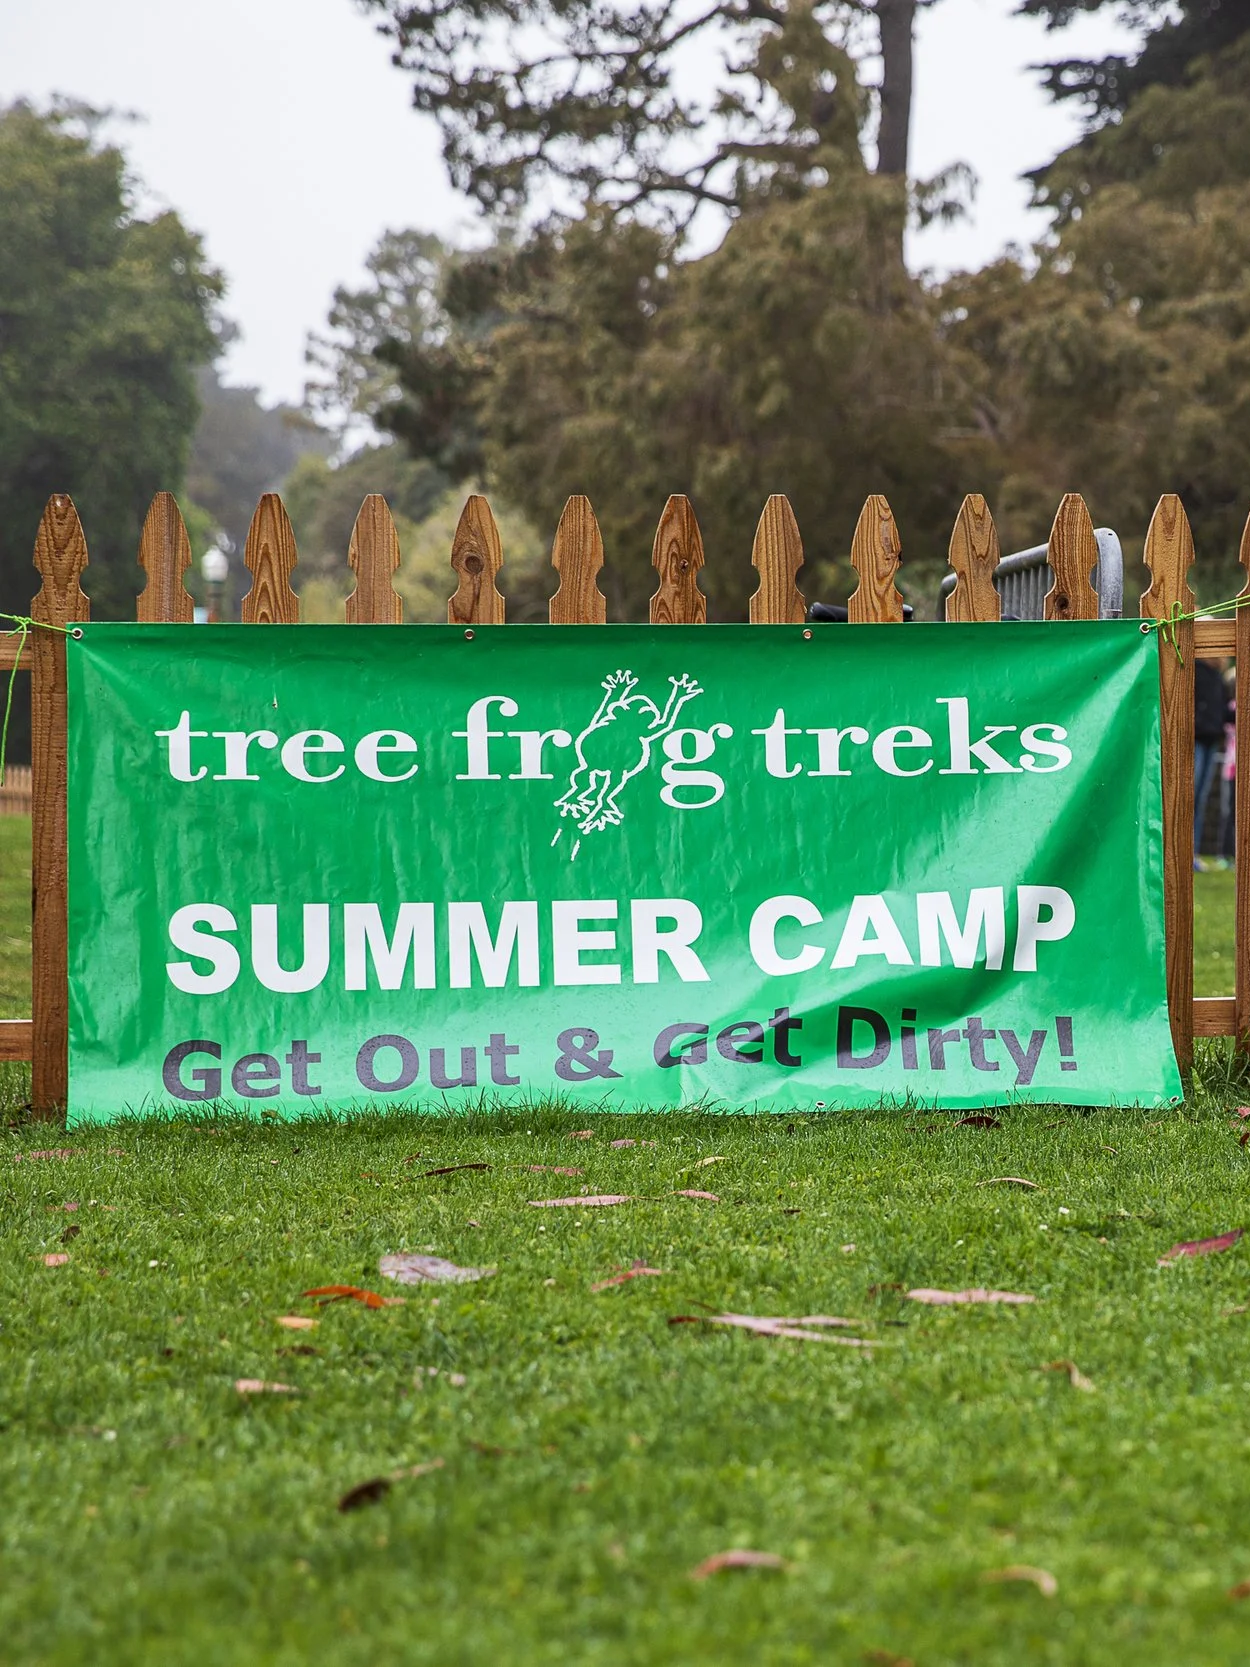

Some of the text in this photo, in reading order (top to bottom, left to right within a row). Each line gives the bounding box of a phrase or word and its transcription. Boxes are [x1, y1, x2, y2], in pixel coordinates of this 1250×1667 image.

[155, 710, 419, 783] tree
[752, 696, 1073, 779] treks
[166, 885, 1076, 994] SUMMER CAMP
[162, 1006, 1078, 1102] Get Out & Get Dirty!
